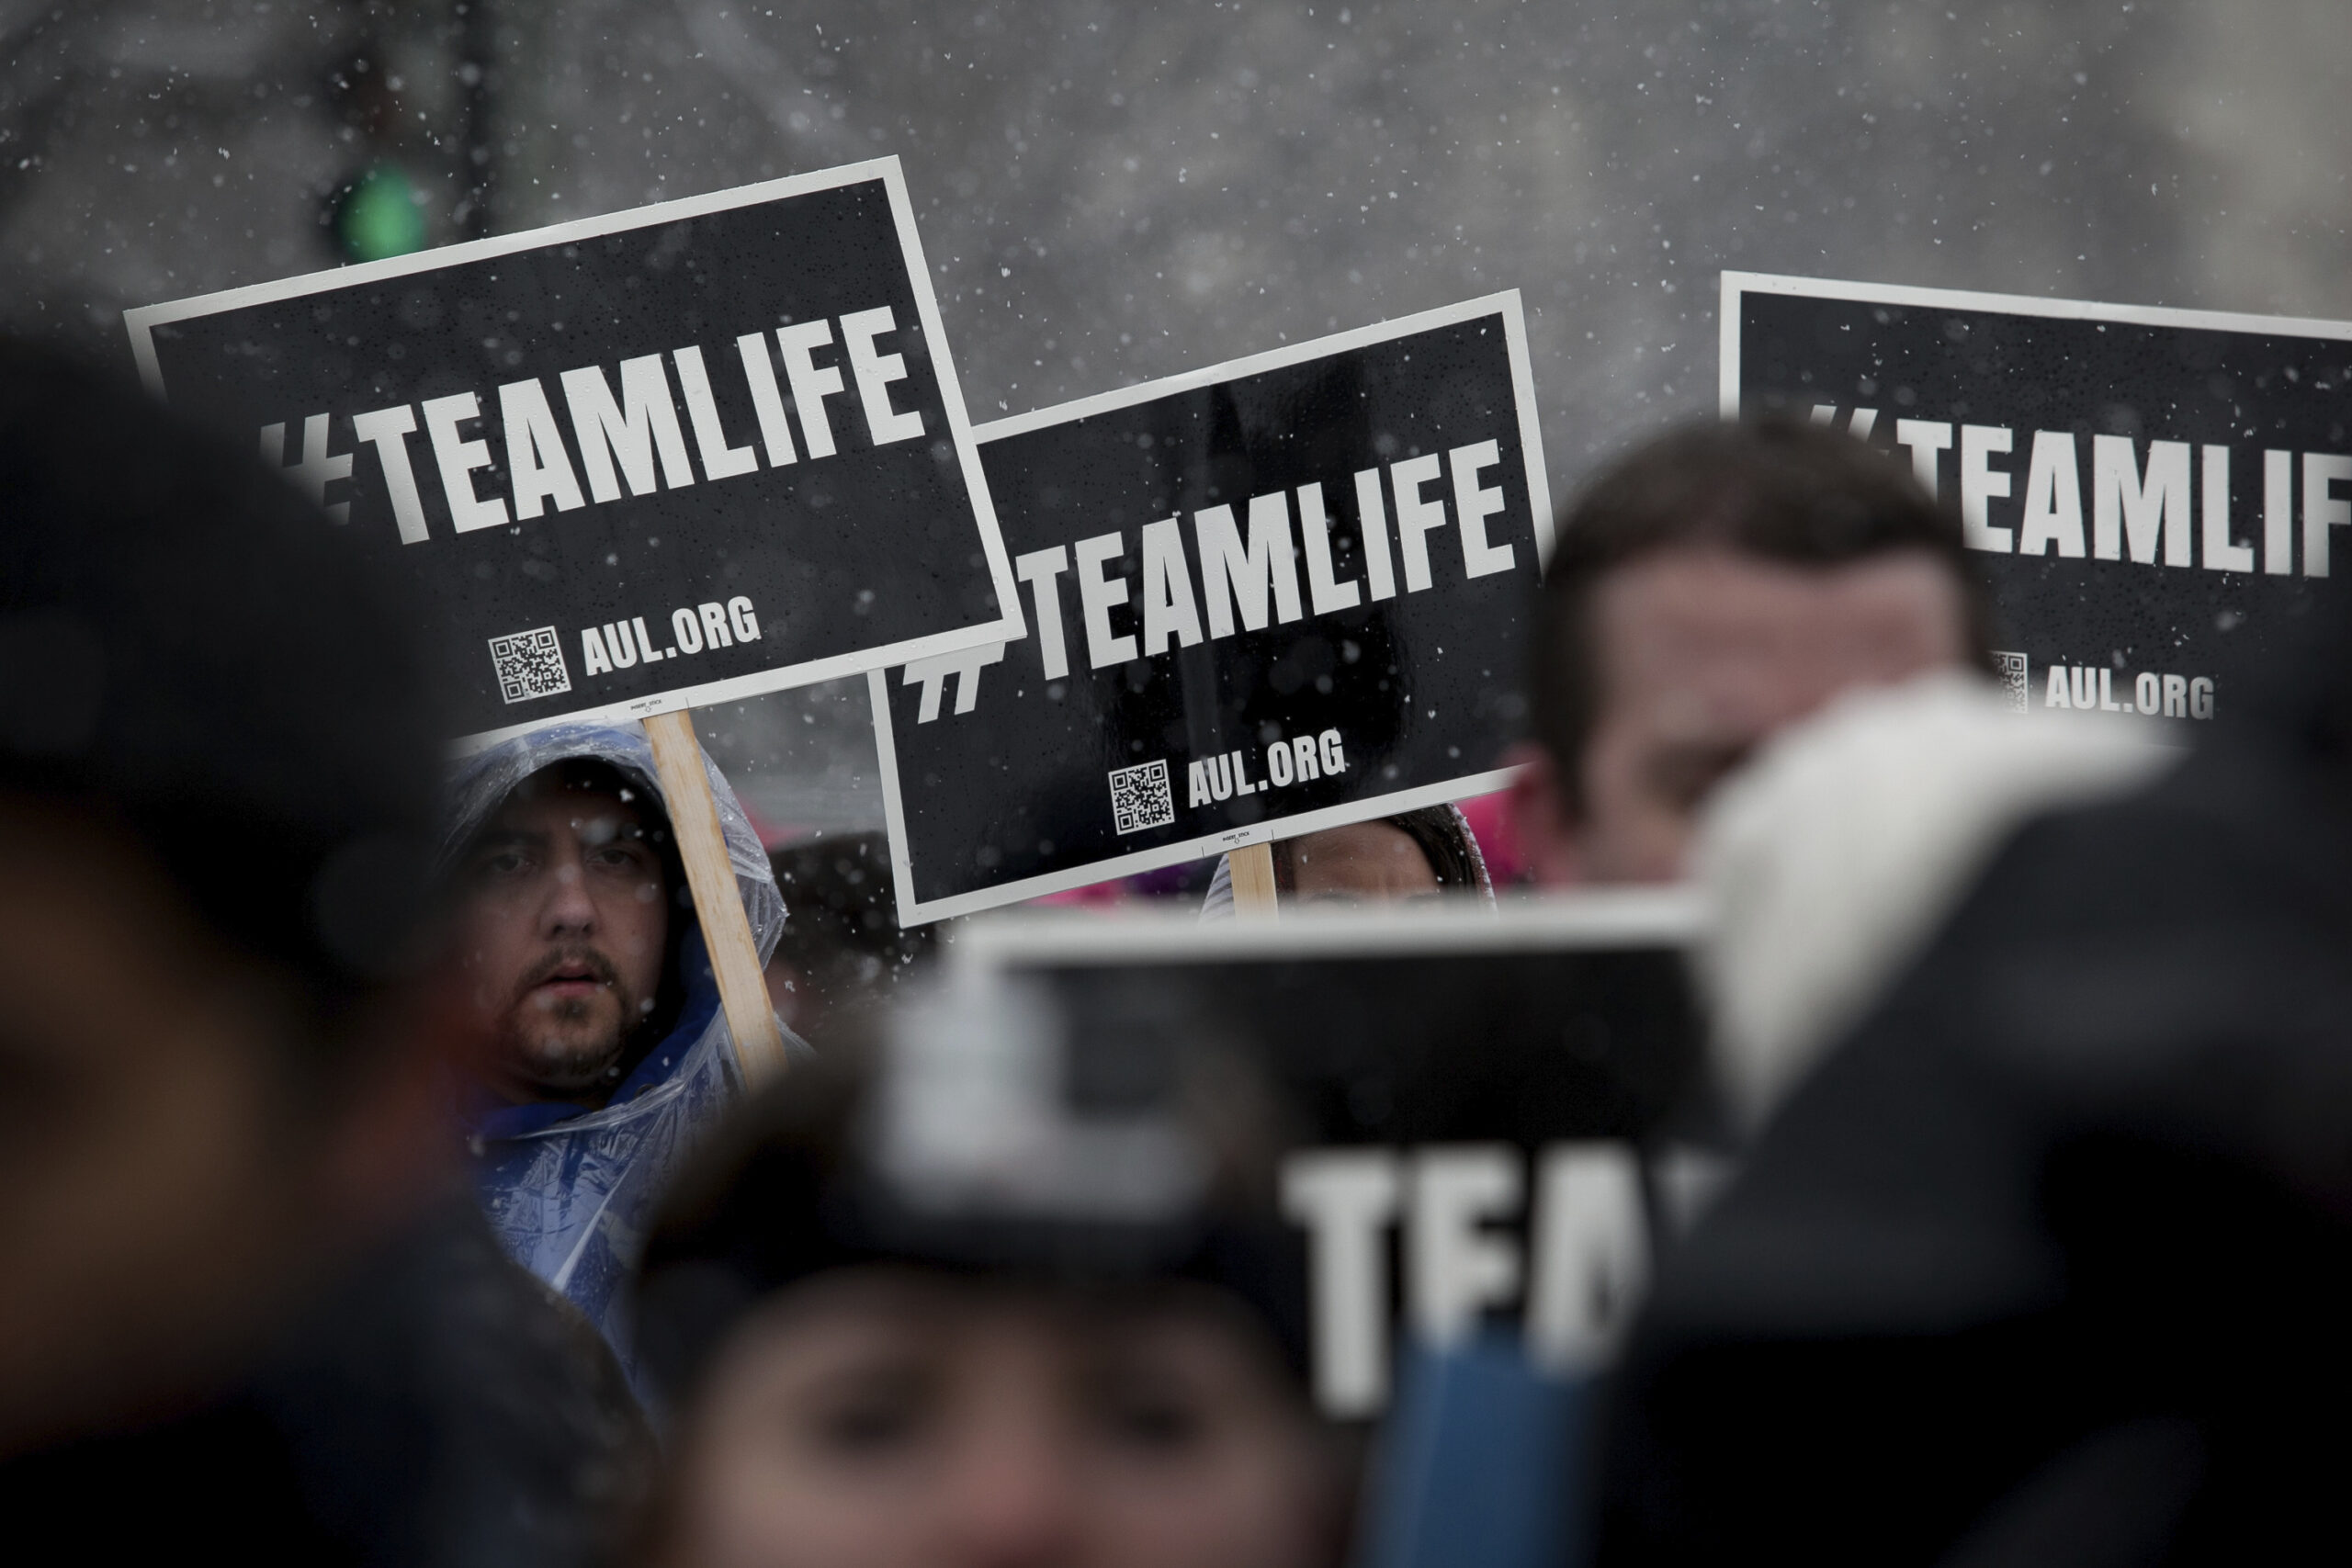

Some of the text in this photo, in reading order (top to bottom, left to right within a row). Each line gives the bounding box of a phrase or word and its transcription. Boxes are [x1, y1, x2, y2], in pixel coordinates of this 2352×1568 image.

[581, 596, 762, 677] AUL.ORG
[2045, 665, 2215, 720] AUL.ORG
[1187, 728, 1346, 808] AUL.ORG
[1278, 1139, 1736, 1420] TEA
